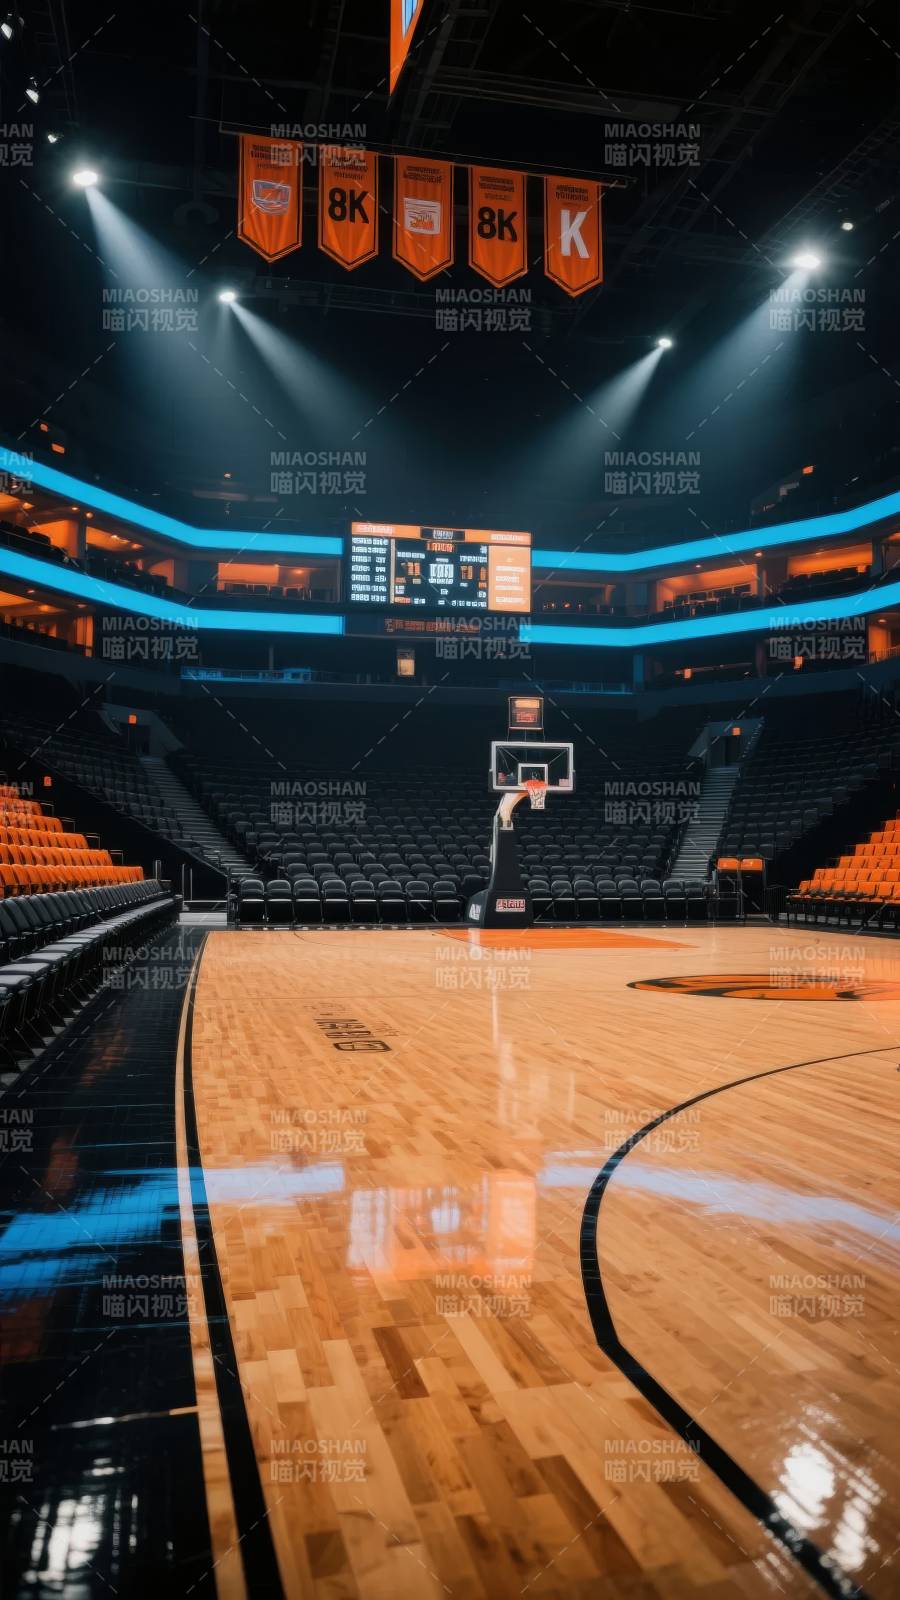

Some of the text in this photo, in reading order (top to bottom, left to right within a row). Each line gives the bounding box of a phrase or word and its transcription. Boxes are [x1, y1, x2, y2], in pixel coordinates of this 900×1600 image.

[328, 187, 369, 224] 8K
[478, 206, 517, 242] 8K
[560, 209, 590, 258] K
